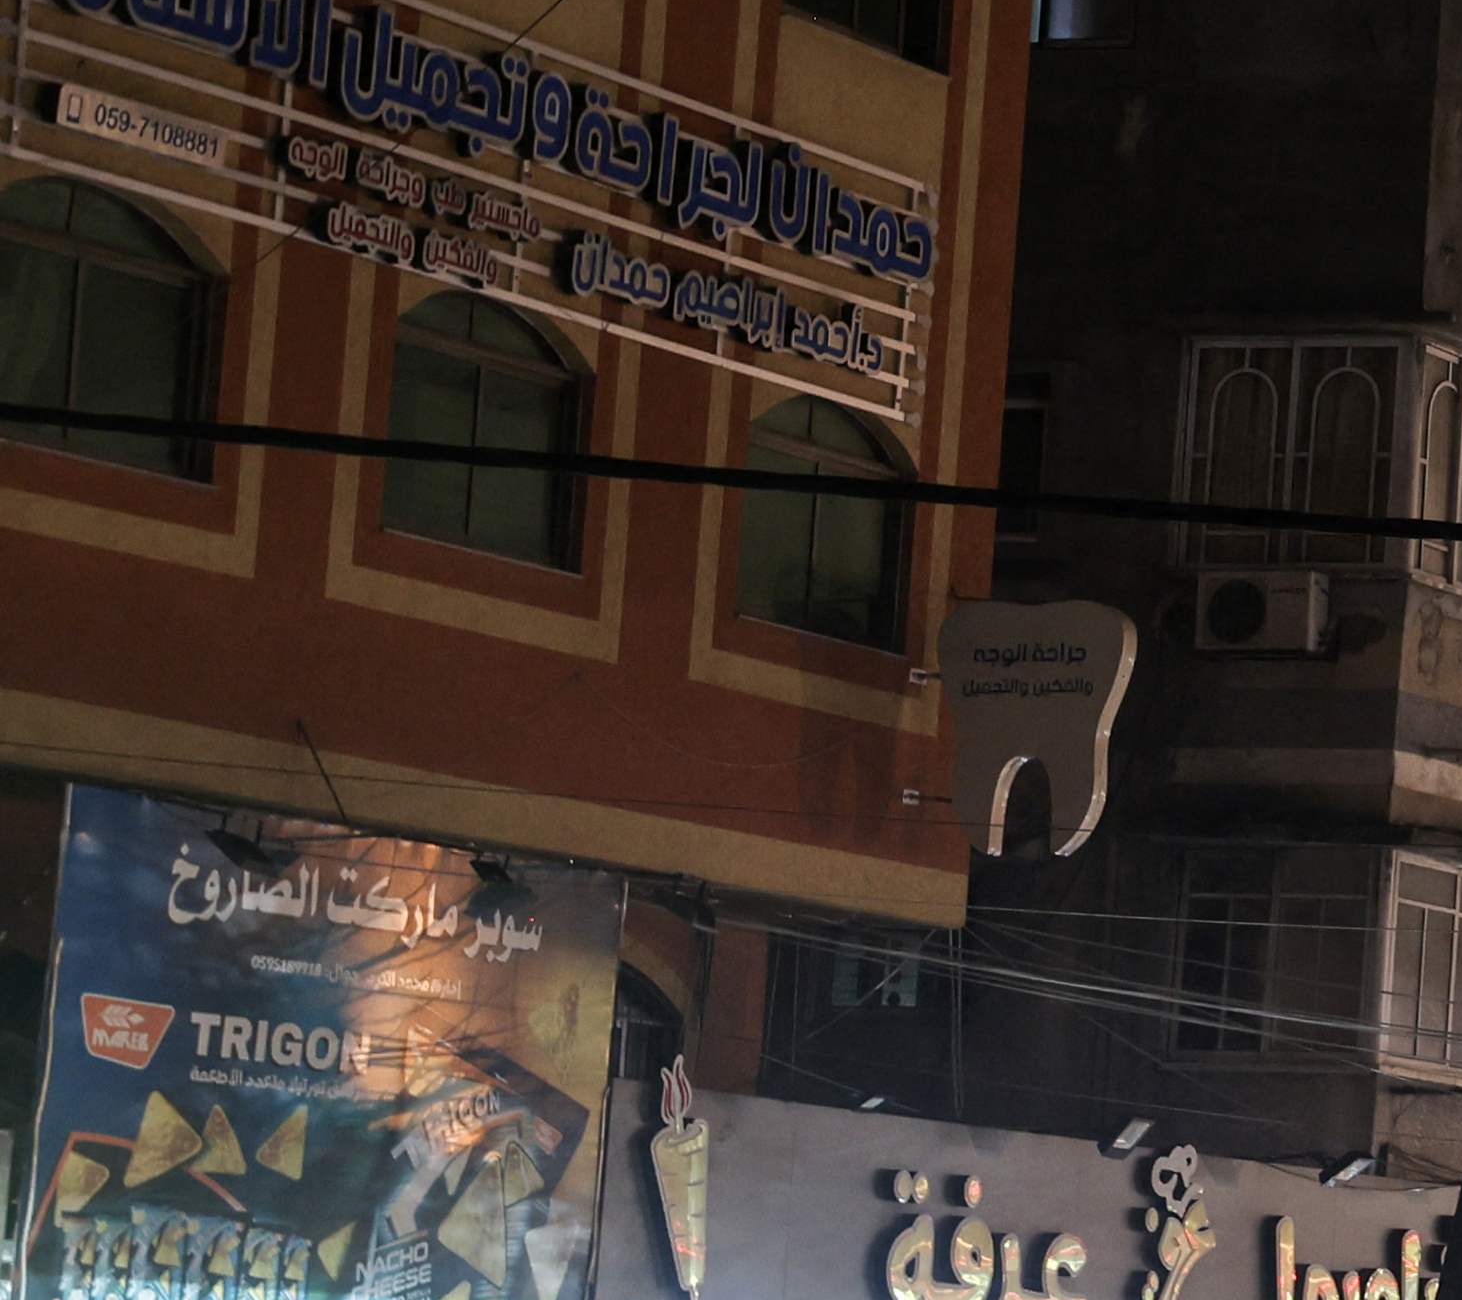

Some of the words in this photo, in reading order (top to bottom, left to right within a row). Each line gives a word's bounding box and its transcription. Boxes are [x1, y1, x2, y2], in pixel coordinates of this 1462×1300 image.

[341, 6, 572, 164] وتجميل
[95, 104, 218, 158] 059-7108881
[289, 136, 349, 181] الوجه
[575, 83, 764, 240] لجراحة
[768, 143, 934, 281] حمدان
[572, 232, 671, 309] حمدان
[168, 842, 320, 924] الصاروخ
[327, 866, 458, 950] ماركت
[464, 908, 542, 962] سوبر
[190, 1011, 371, 1074] TRIGON
[356, 1241, 429, 1283] NACHO
